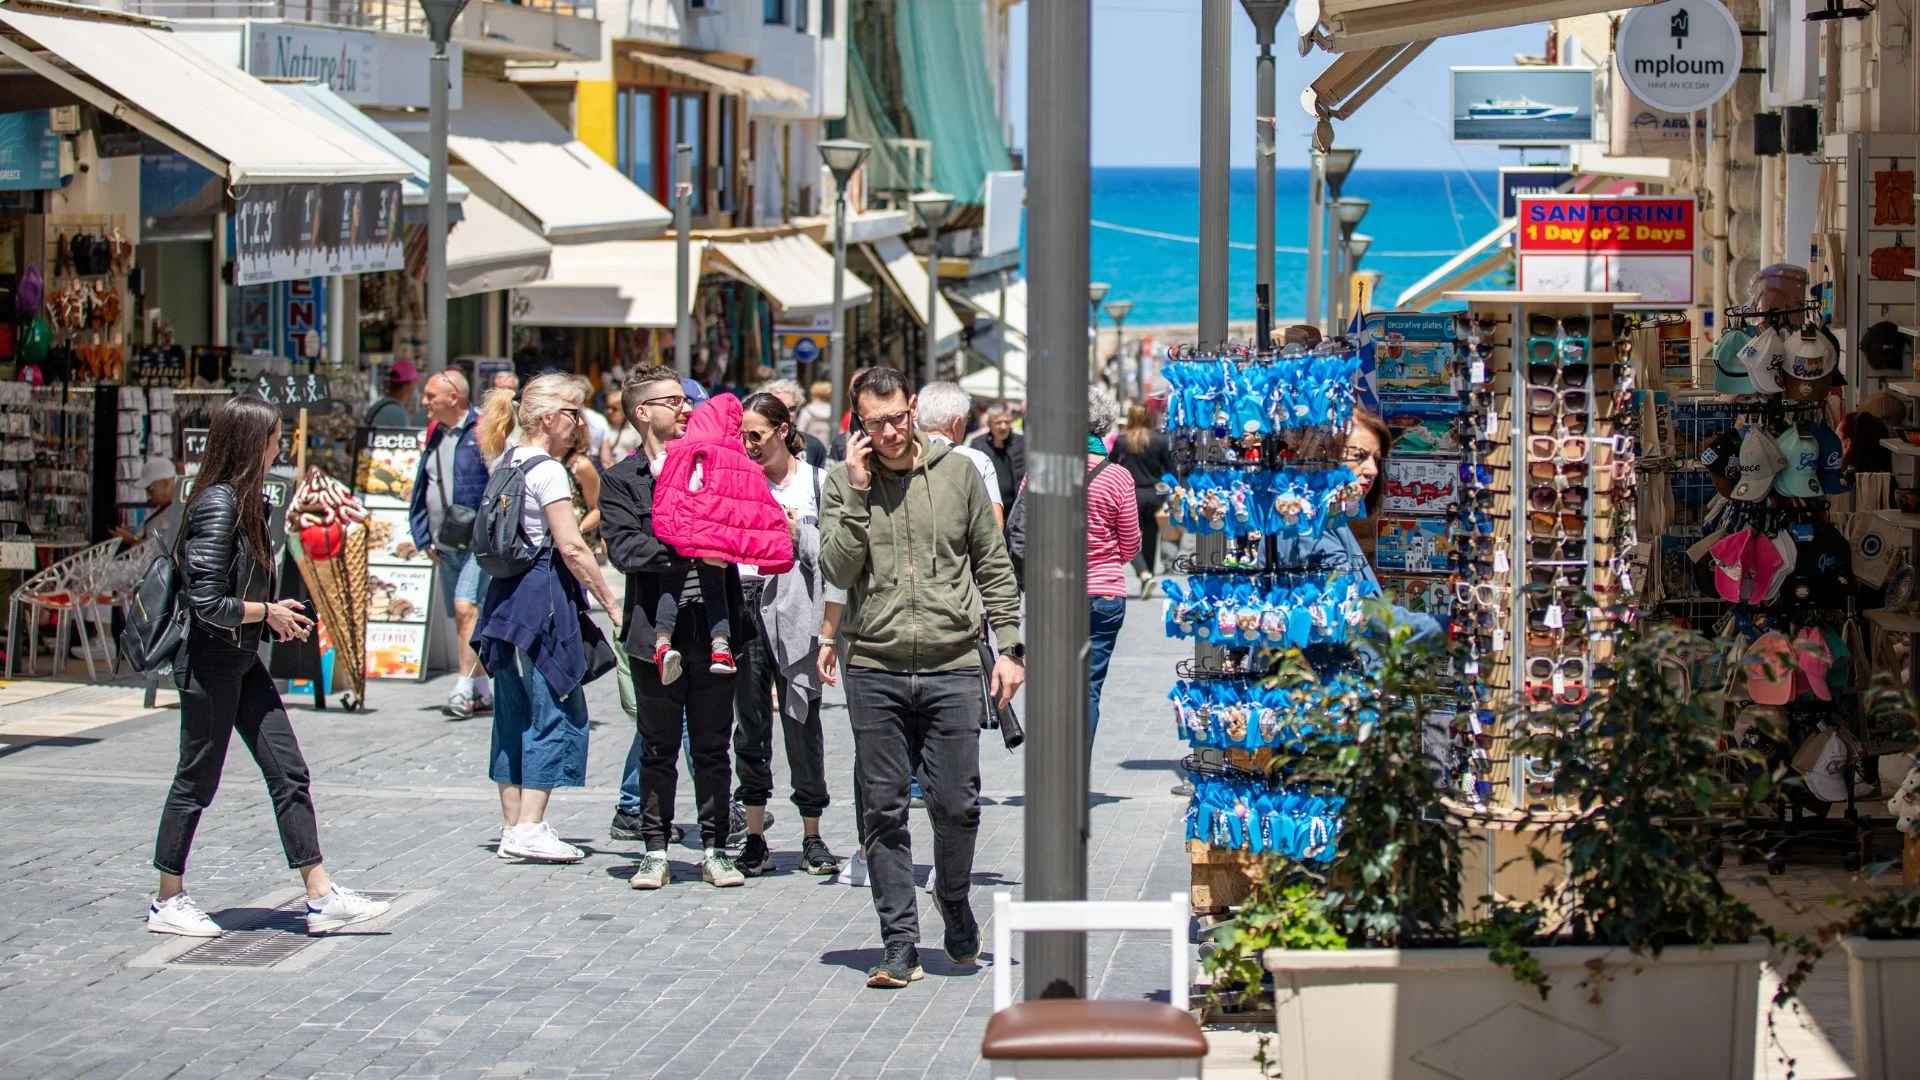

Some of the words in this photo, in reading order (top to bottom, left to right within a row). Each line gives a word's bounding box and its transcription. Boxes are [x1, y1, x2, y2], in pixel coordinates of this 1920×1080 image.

[1635, 54, 1724, 77] mploum
[1530, 204, 1684, 222] SANTORINI
[1527, 225, 1538, 240] 1
[1545, 226, 1585, 243] Day
[1590, 228, 1612, 240] or
[1617, 225, 1630, 240] 2
[1636, 226, 1686, 243] Days
[1388, 320, 1421, 329] decorative
[1422, 321, 1443, 330] plates
